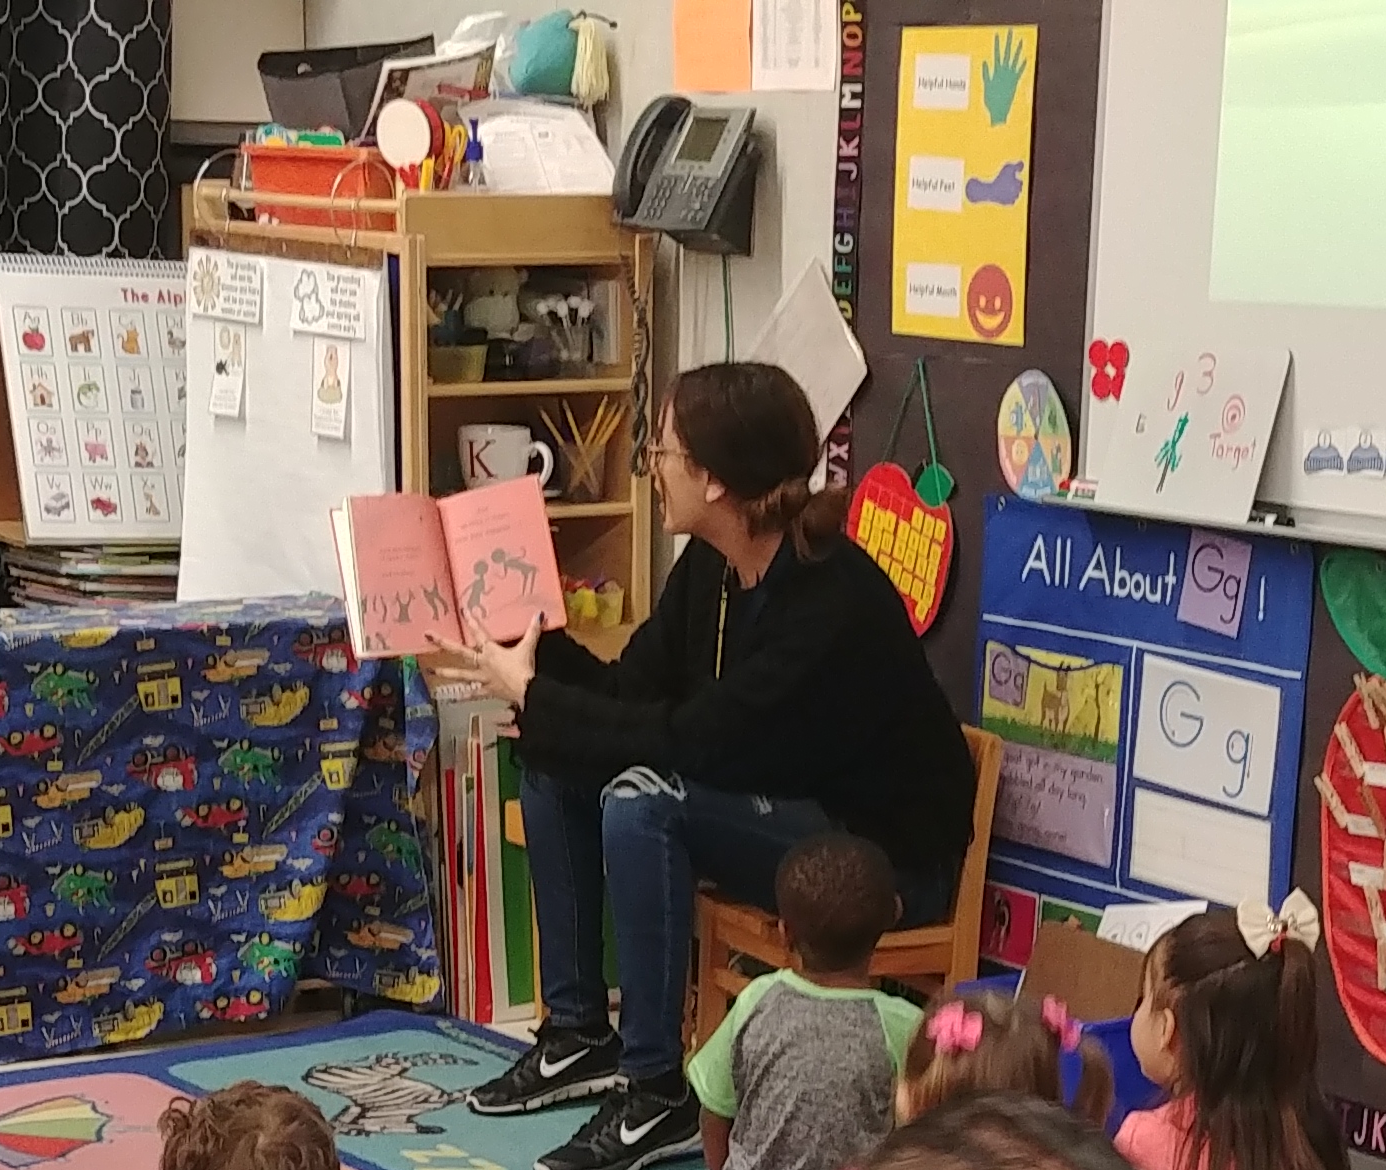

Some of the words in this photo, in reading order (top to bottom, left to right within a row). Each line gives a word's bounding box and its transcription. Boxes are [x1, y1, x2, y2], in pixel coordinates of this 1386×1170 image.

[918, 76, 943, 92] Helpful
[912, 178, 937, 193] Helpful
[939, 181, 955, 192] Feet
[120, 287, 150, 304] The
[909, 283, 935, 297] Helpful
[936, 287, 958, 298] Mouth
[1196, 352, 1216, 396] 3
[465, 439, 497, 480] K
[1209, 432, 1257, 470] Target
[1021, 533, 1072, 590] All
[1078, 542, 1177, 606] About
[1191, 543, 1242, 625] Gg
[991, 651, 1026, 693] Gg
